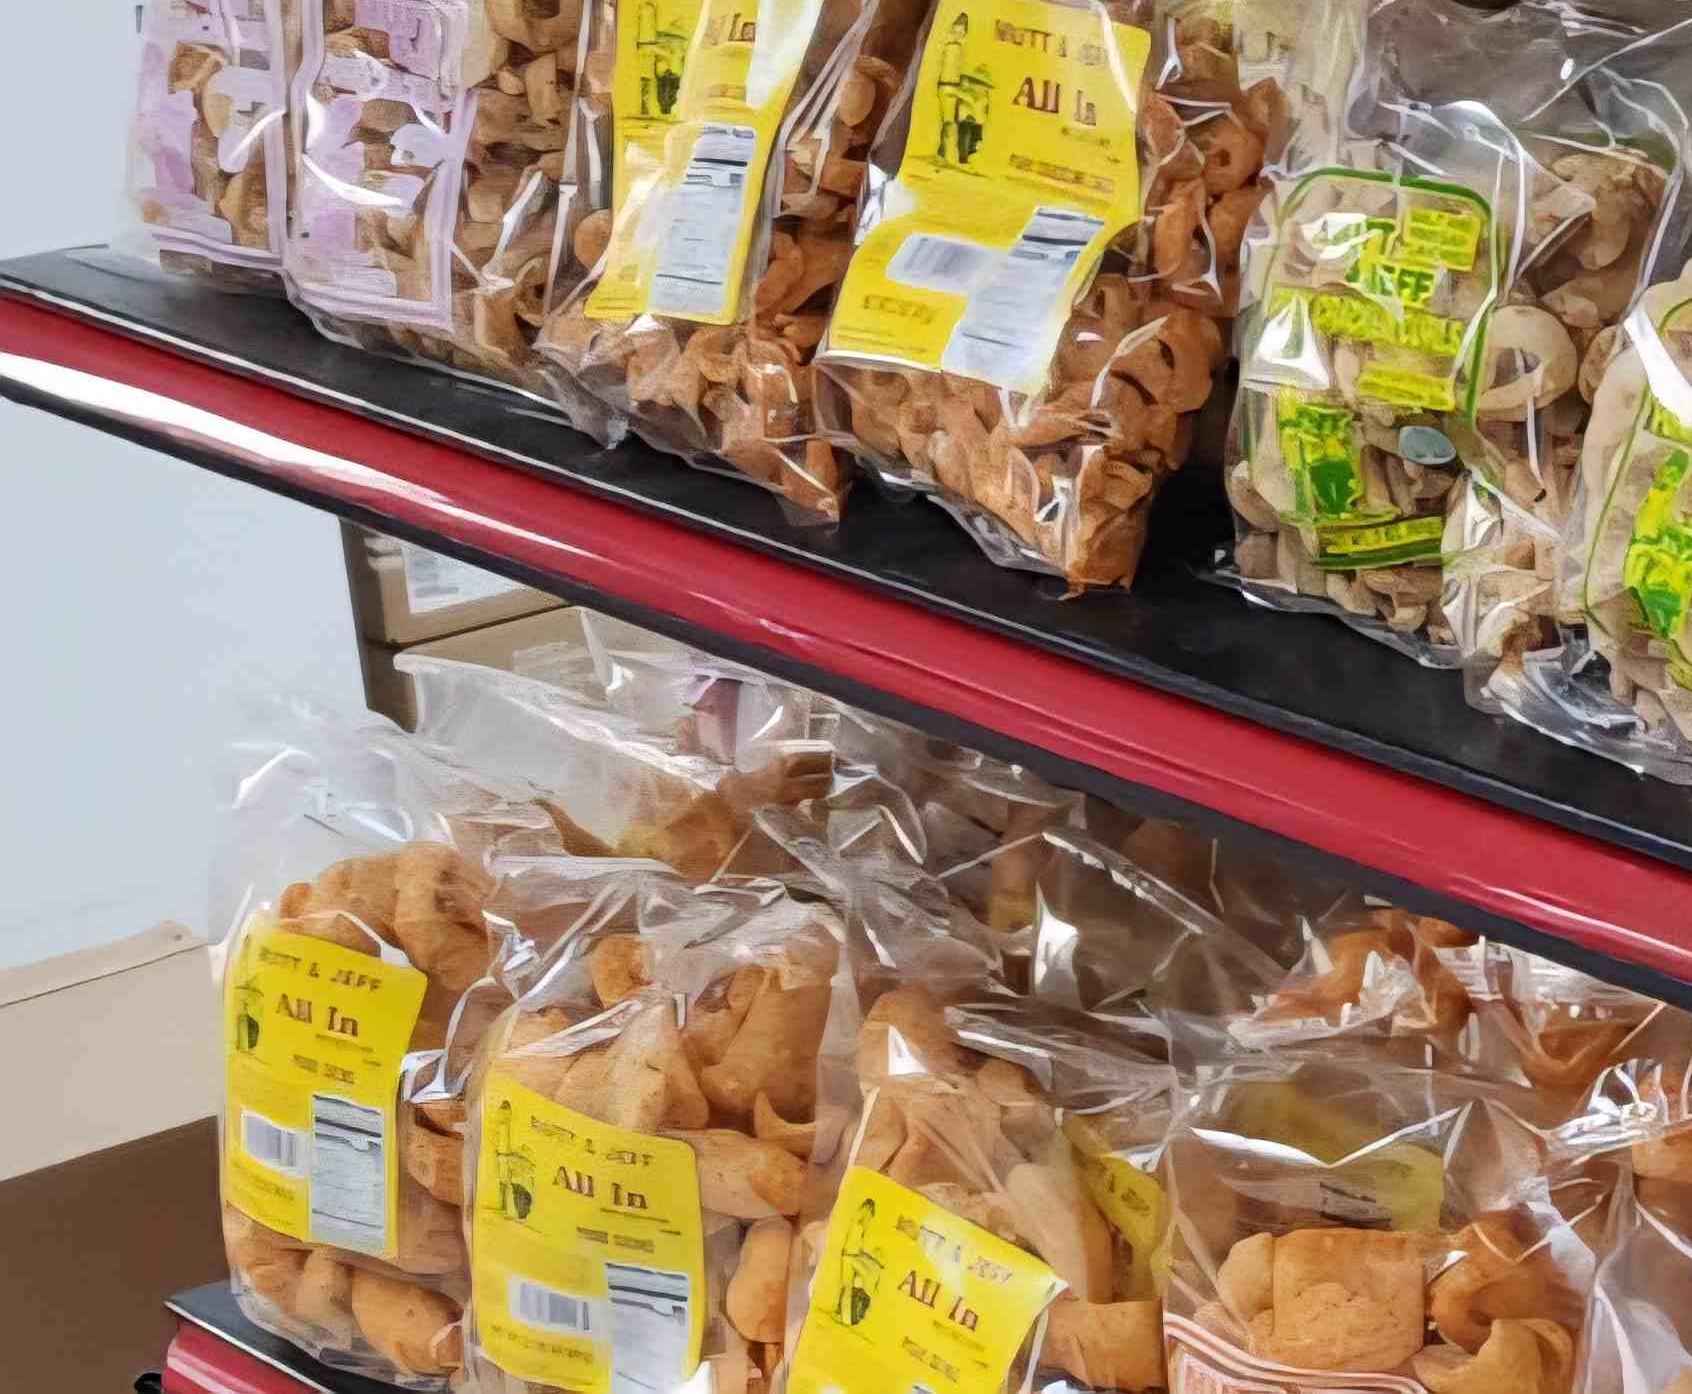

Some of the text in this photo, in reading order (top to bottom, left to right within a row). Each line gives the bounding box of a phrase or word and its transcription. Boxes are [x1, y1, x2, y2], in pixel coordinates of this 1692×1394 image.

[1013, 76, 1061, 114] All
[275, 992, 359, 1038] All In
[552, 1165, 595, 1199] All
[897, 1270, 979, 1333] All In
